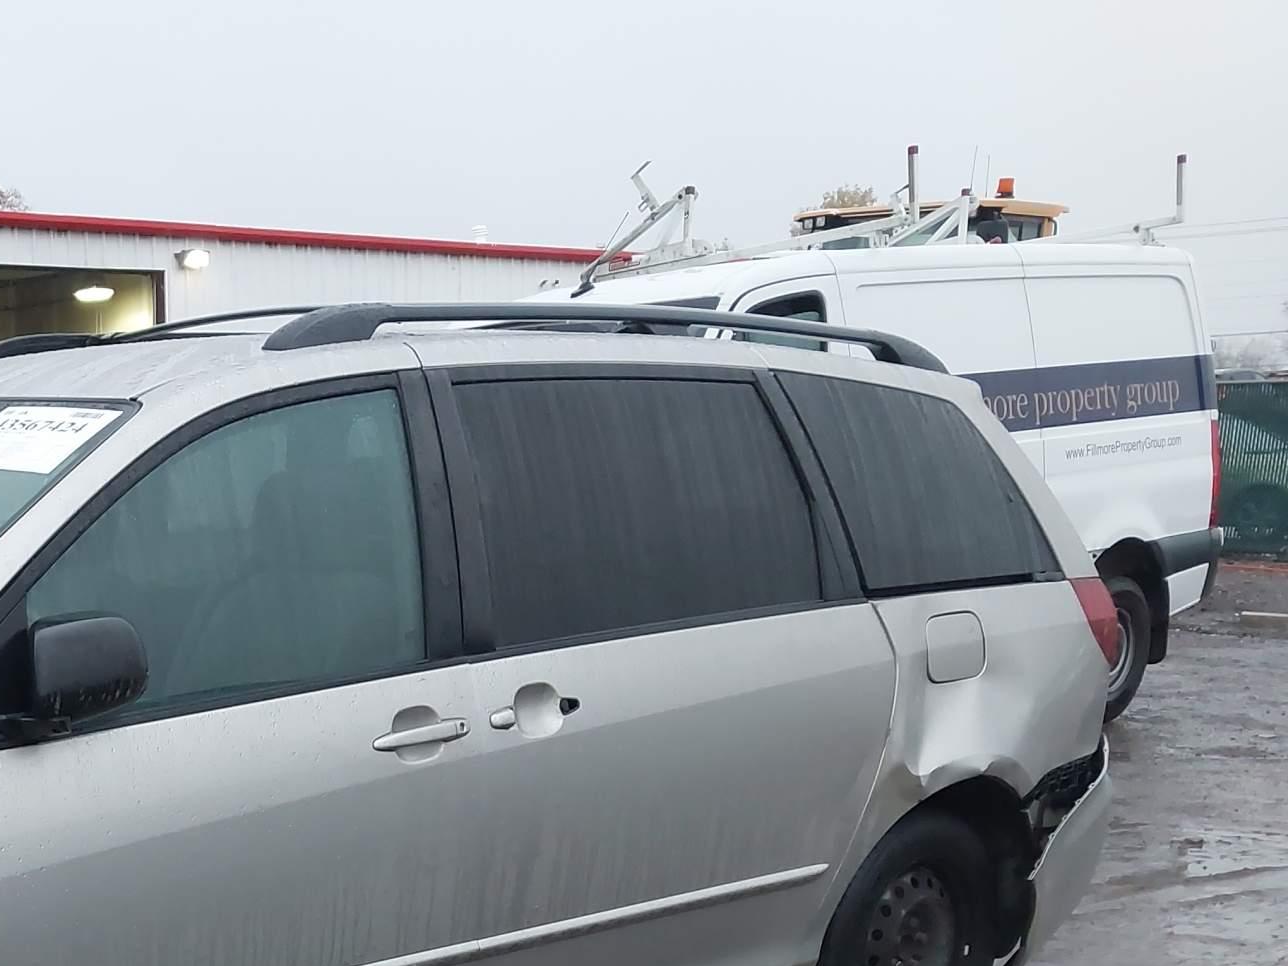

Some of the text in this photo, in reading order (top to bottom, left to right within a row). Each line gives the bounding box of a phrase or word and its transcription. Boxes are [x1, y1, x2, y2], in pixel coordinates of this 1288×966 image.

[1033, 383, 1120, 425] property
[1126, 378, 1180, 414] group
[1065, 435, 1182, 459] www.FillmorePropertyGroup.com
